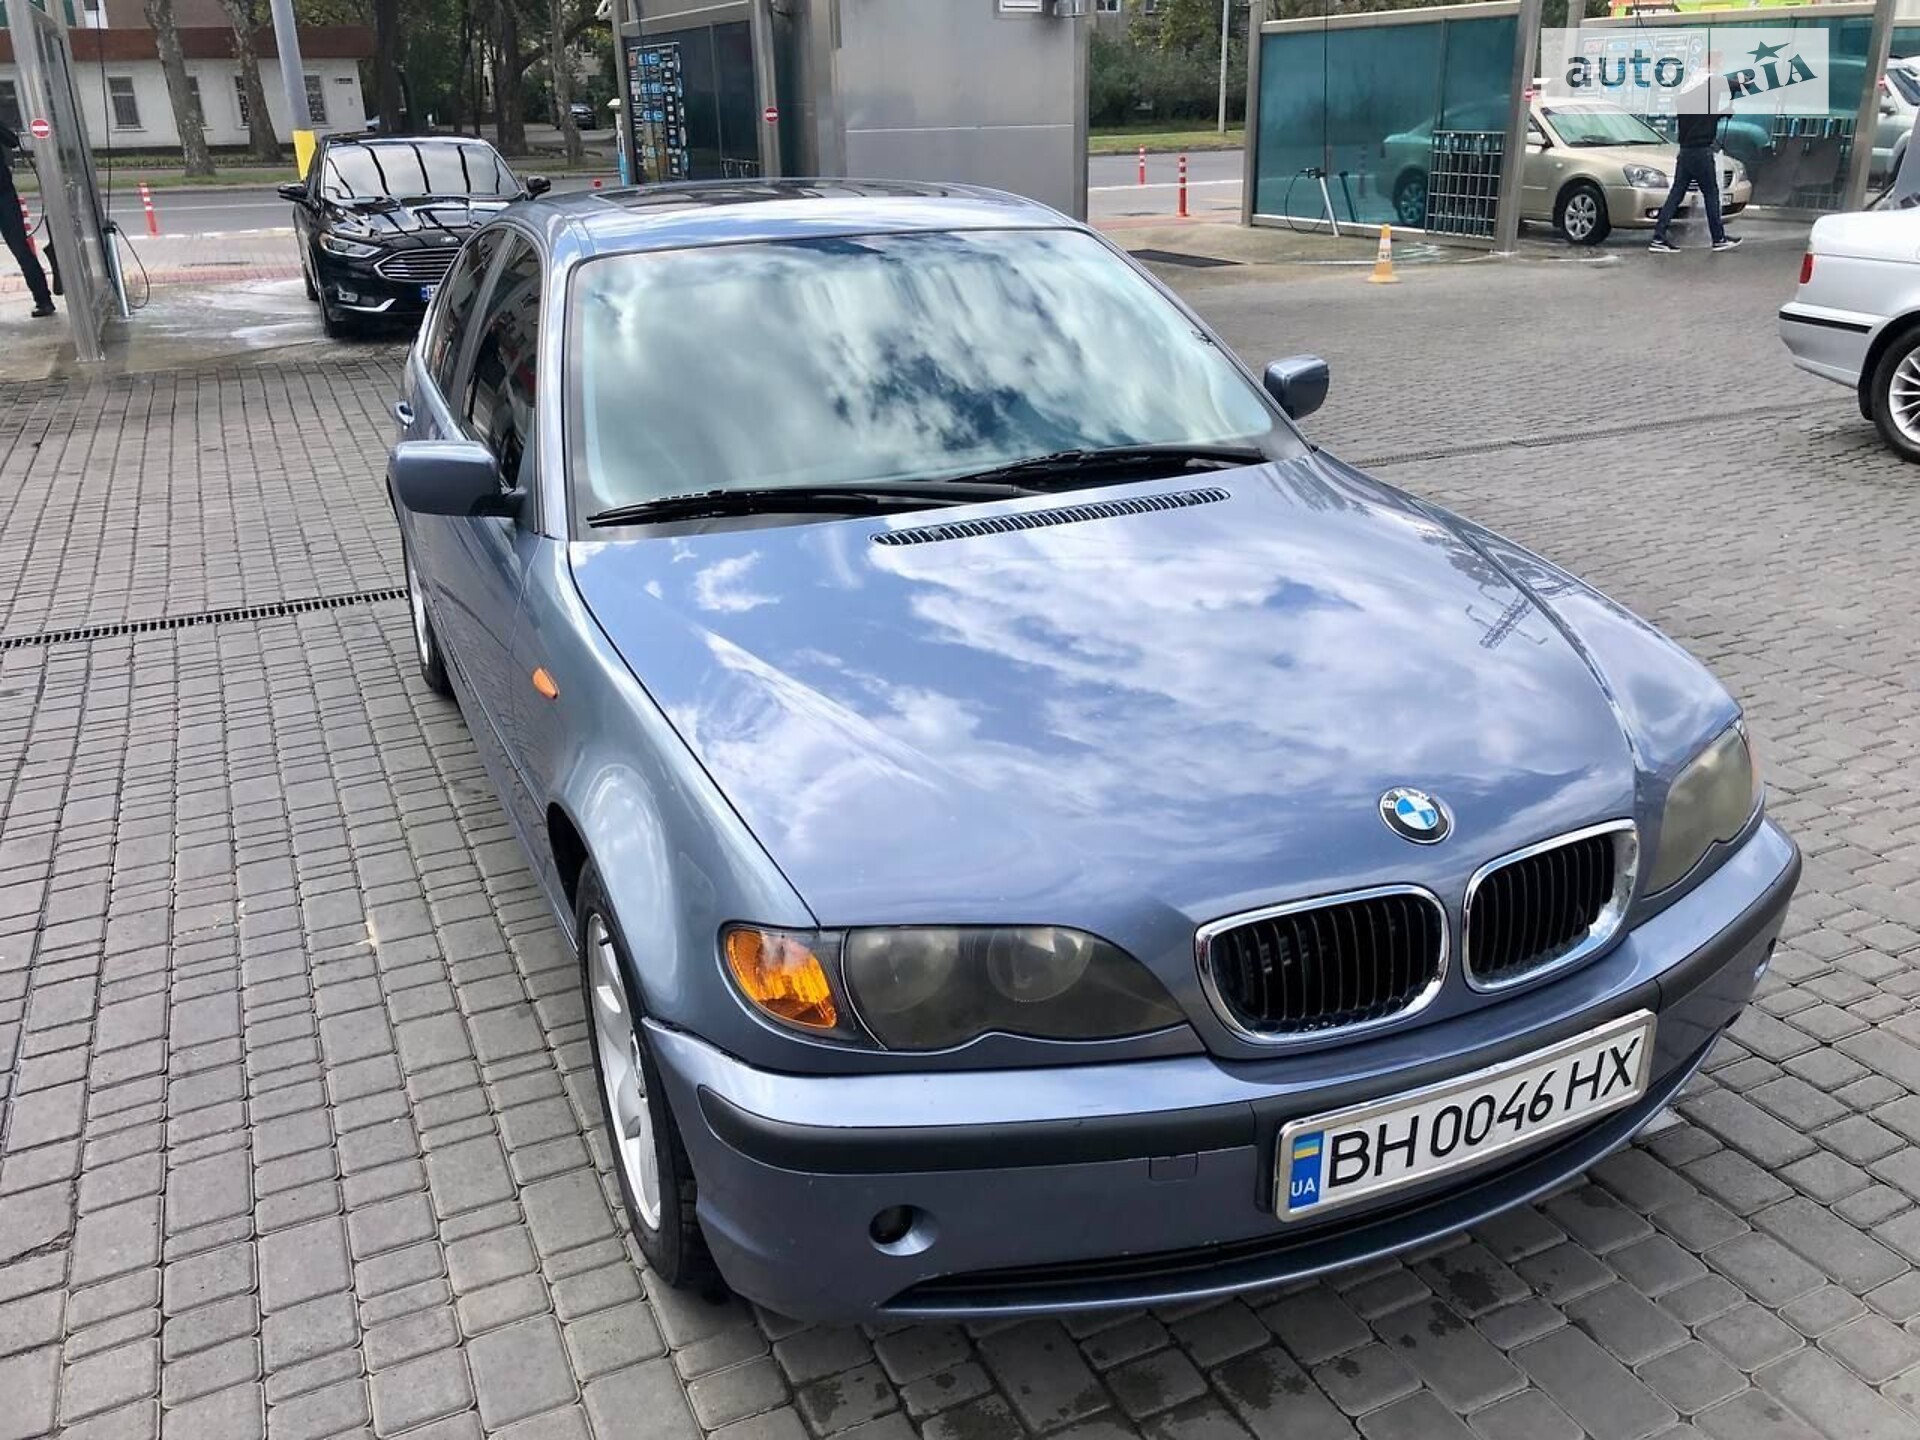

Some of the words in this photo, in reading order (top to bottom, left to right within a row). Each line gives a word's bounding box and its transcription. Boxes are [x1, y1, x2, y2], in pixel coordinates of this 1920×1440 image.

[1328, 1115, 1420, 1188] BH
[1430, 1070, 1557, 1158] 0046
[1564, 1036, 1640, 1111] HX
[1291, 1177, 1316, 1197] UA
